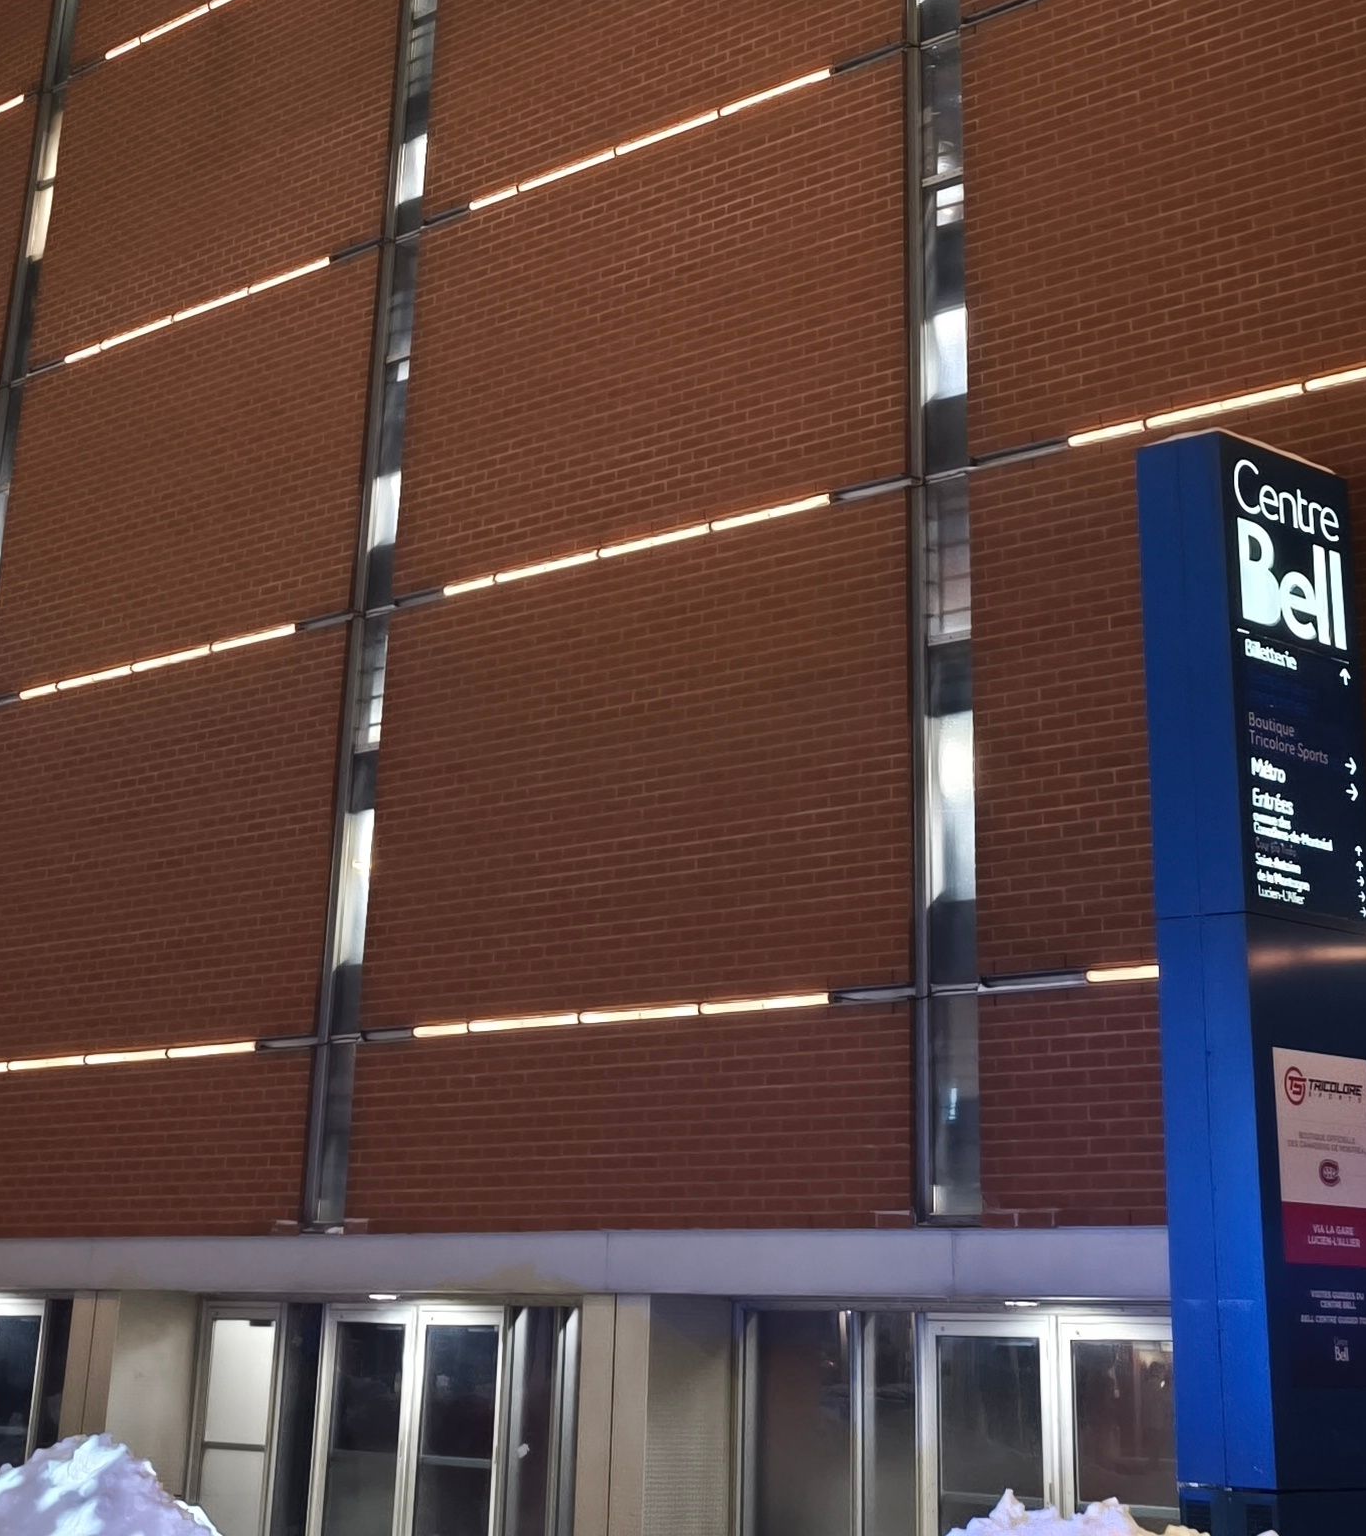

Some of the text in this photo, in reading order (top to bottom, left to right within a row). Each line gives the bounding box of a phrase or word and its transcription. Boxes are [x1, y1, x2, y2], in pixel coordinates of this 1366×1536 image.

[1233, 459, 1340, 543] Centre
[1236, 517, 1348, 651] Bell
[1244, 638, 1298, 671] Billetterie
[1248, 711, 1295, 738] Boutique
[1249, 729, 1329, 765] Tricolore Sports
[1250, 756, 1287, 784] Métro
[1252, 787, 1294, 816] Entrées
[1308, 1078, 1363, 1097] TRICOLORE
[1312, 1224, 1354, 1236] VIA LA GARE
[1334, 1346, 1350, 1362] Bell
